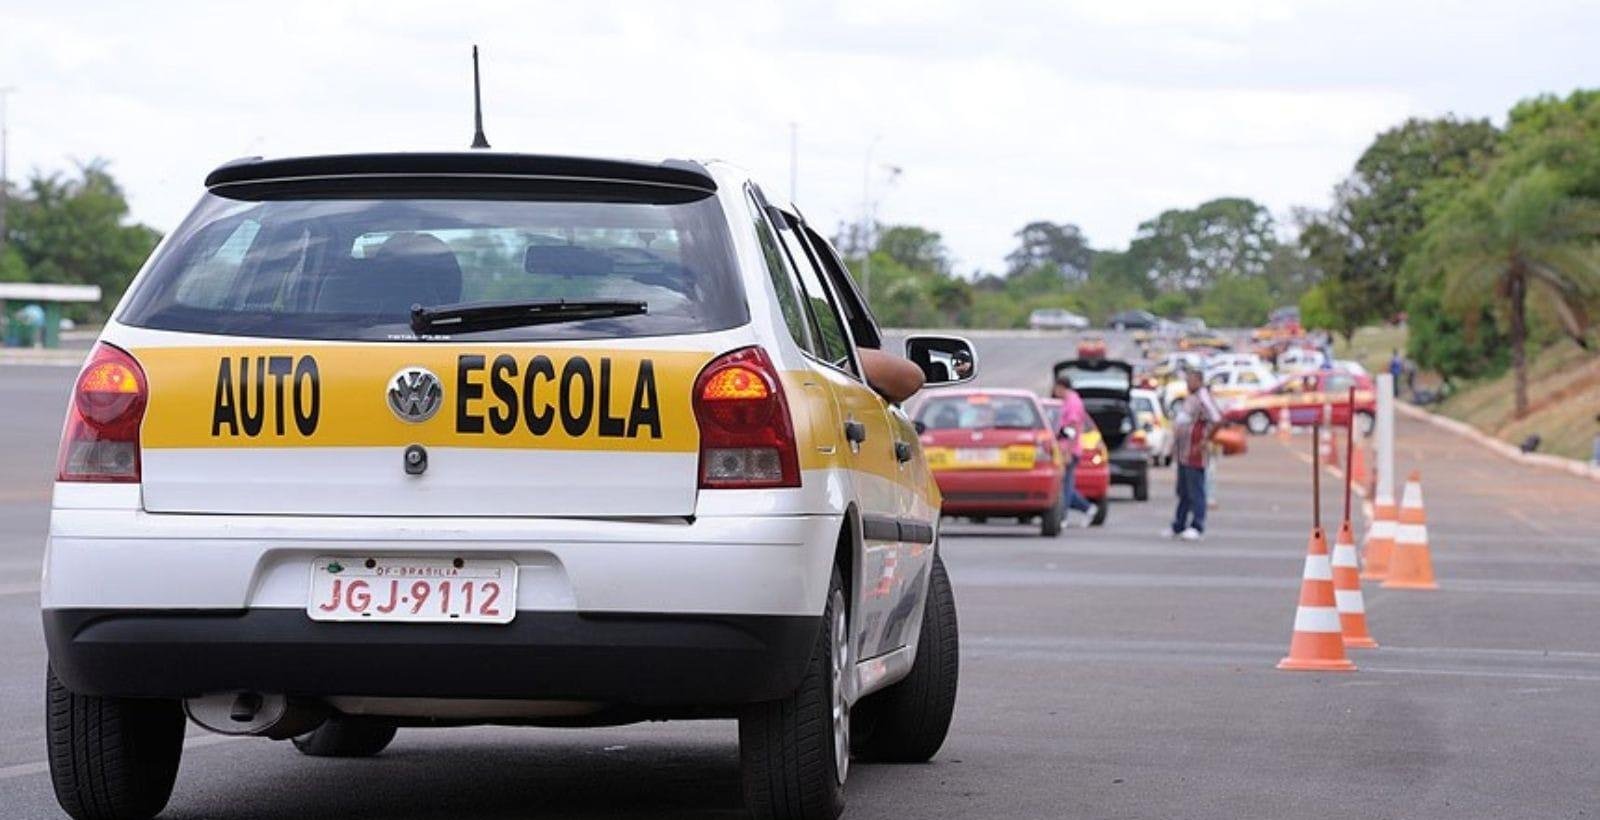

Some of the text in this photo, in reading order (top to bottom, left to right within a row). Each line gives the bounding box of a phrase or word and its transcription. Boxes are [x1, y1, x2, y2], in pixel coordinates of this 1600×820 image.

[211, 354, 662, 439] AUTO ESCOLA
[387, 367, 443, 422] VW
